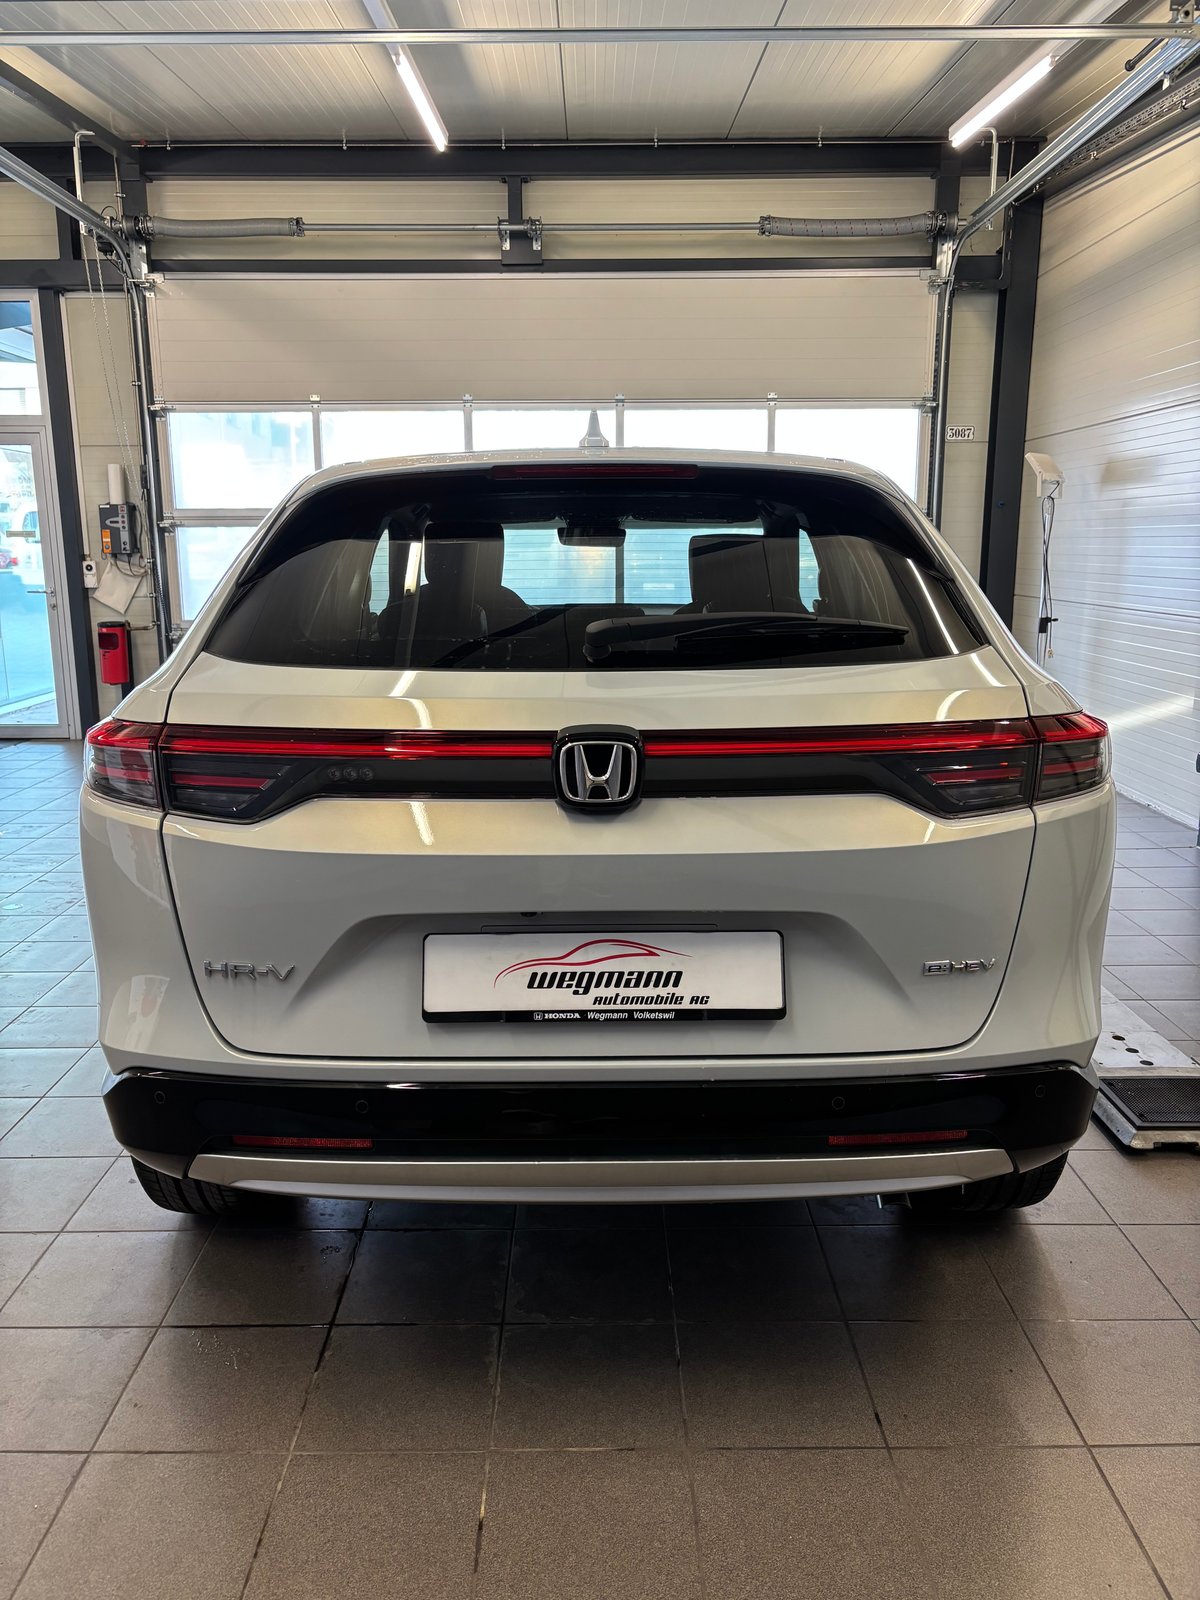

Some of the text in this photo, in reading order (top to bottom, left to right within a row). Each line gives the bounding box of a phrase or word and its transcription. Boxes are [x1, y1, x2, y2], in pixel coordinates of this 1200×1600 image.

[948, 428, 972, 438] 3087
[203, 960, 295, 981] HR-V
[527, 971, 683, 996] wegmann
[689, 995, 710, 1005] AG
[587, 1012, 628, 1021] Wegmann
[633, 1011, 675, 1020] Volketswil
